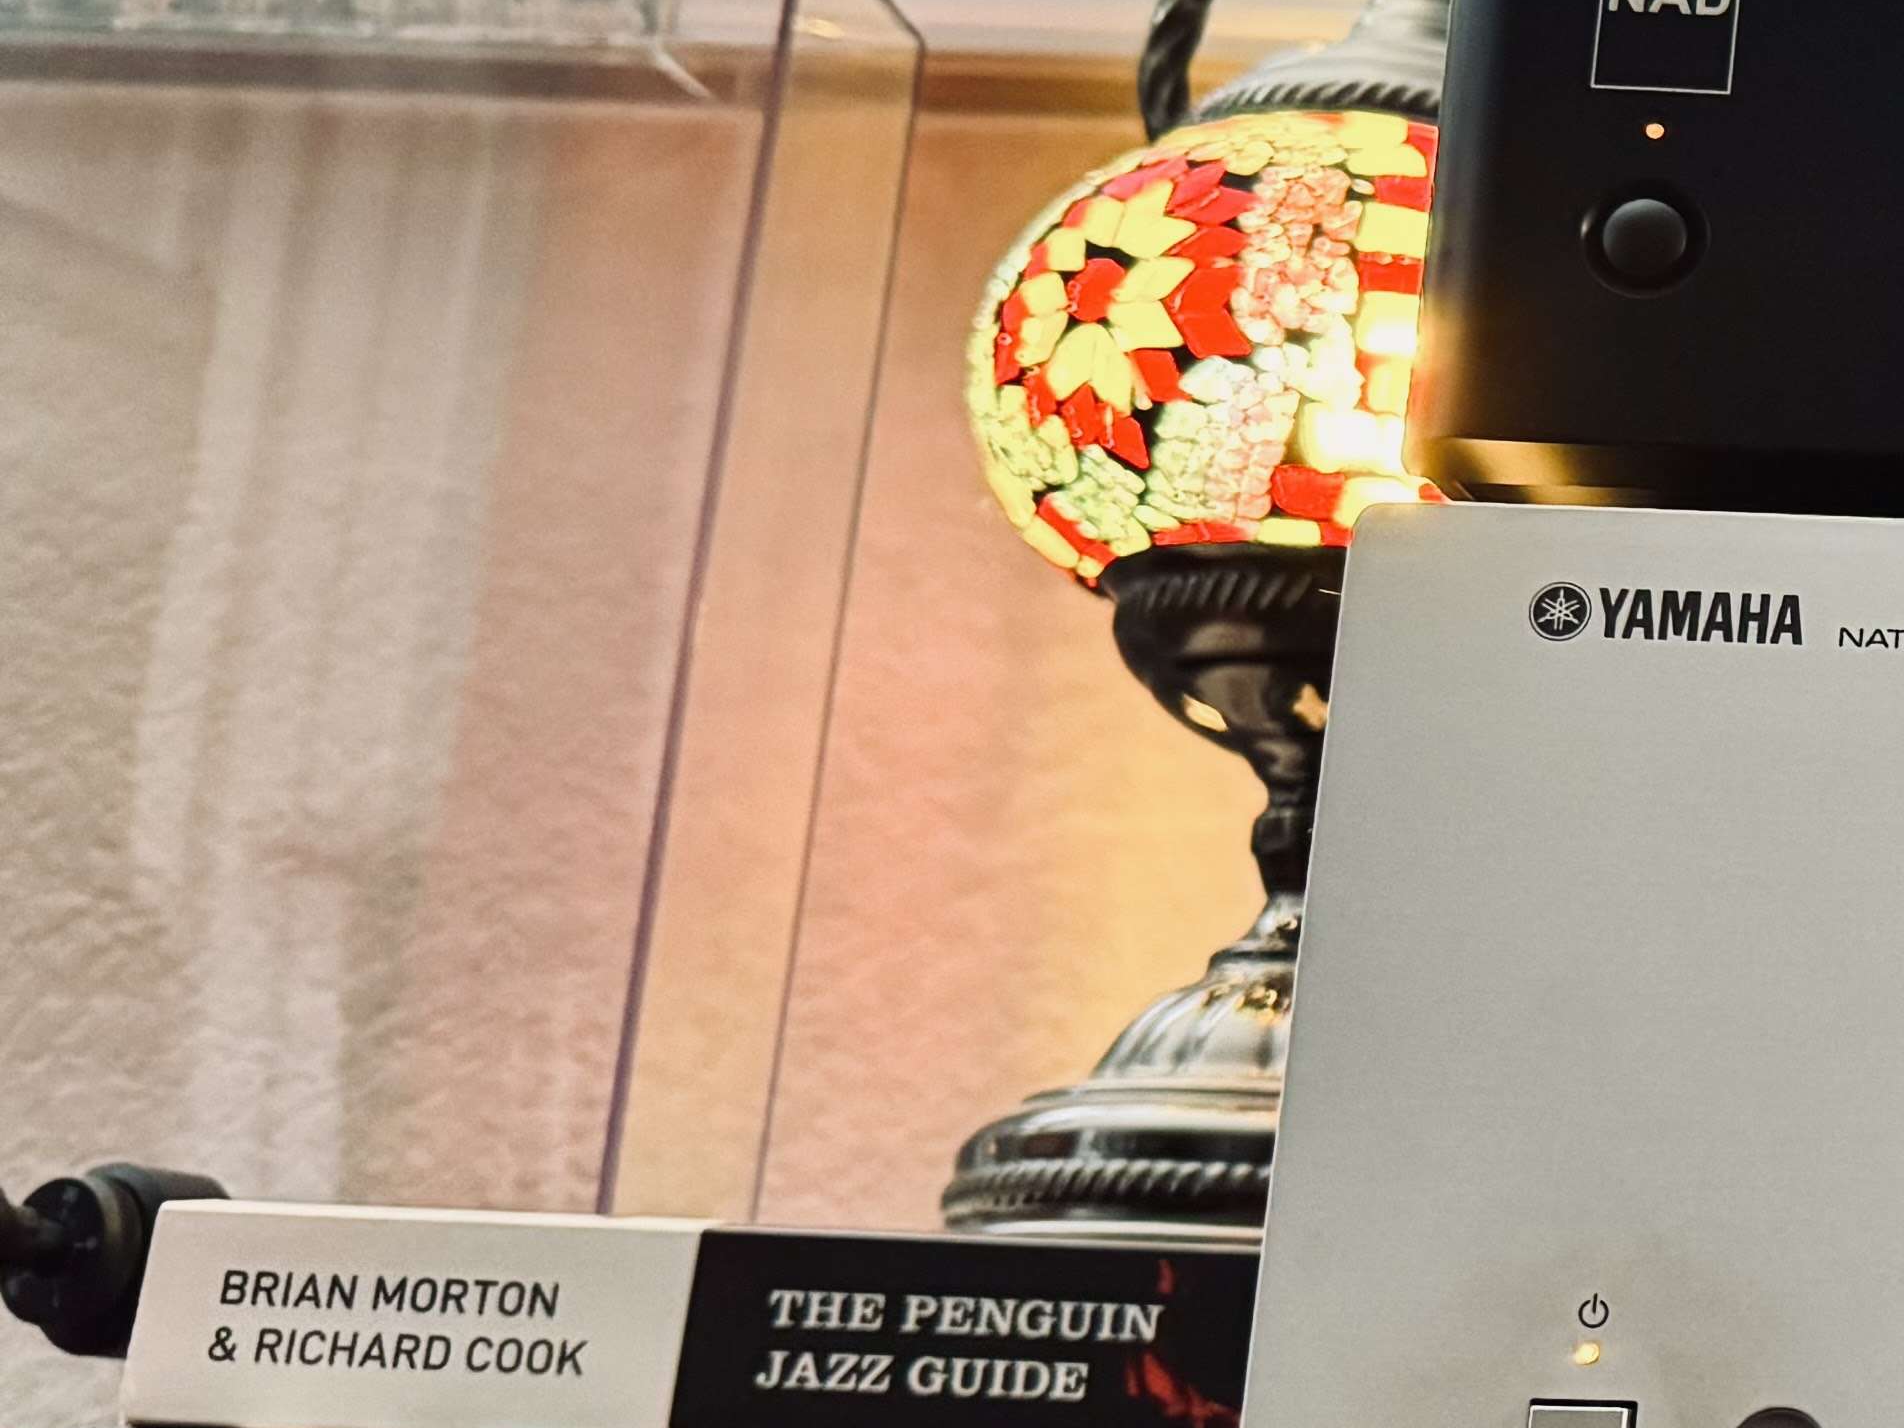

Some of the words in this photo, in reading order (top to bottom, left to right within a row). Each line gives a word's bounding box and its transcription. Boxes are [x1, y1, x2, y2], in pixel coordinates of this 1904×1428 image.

[1599, 587, 1803, 646] YAMAHA
[219, 1269, 359, 1310] BRIAN
[371, 1275, 560, 1318] MORTON
[769, 1289, 886, 1331] THE
[901, 1294, 1163, 1342] PENGUIN
[207, 1326, 237, 1362] &
[254, 1327, 452, 1371] RICHARD
[465, 1336, 588, 1376] COOK
[755, 1350, 893, 1393] JAZZ
[907, 1355, 1089, 1401] GUIDE
